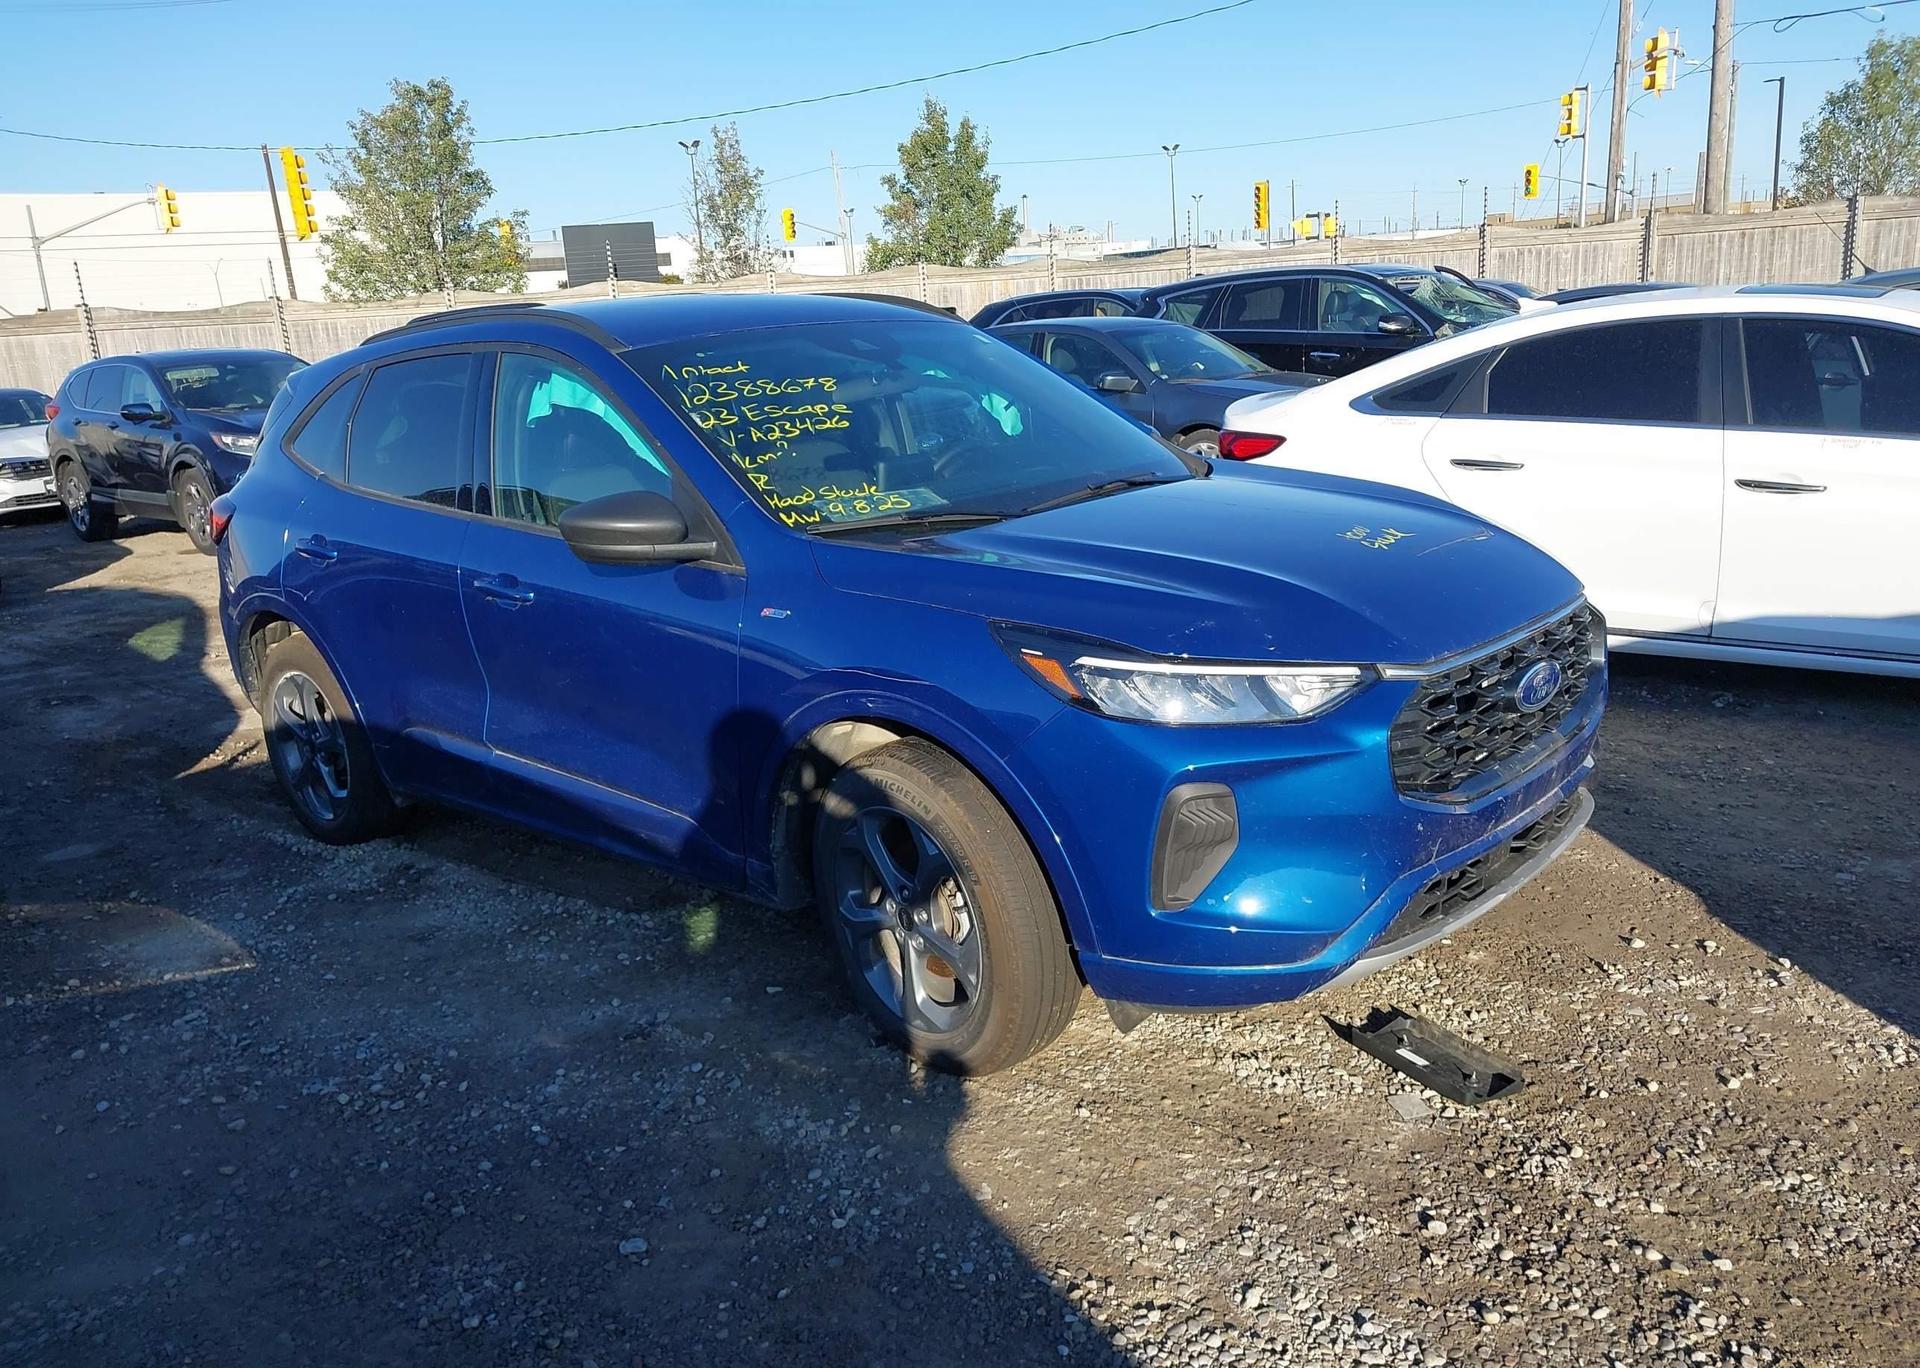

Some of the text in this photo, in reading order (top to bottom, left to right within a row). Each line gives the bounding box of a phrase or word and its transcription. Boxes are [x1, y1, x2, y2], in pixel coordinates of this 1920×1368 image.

[661, 360, 751, 381] Intact
[673, 377, 838, 409] 12388678
[740, 403, 854, 421] Escape
[873, 777, 932, 816] MICHELIN
